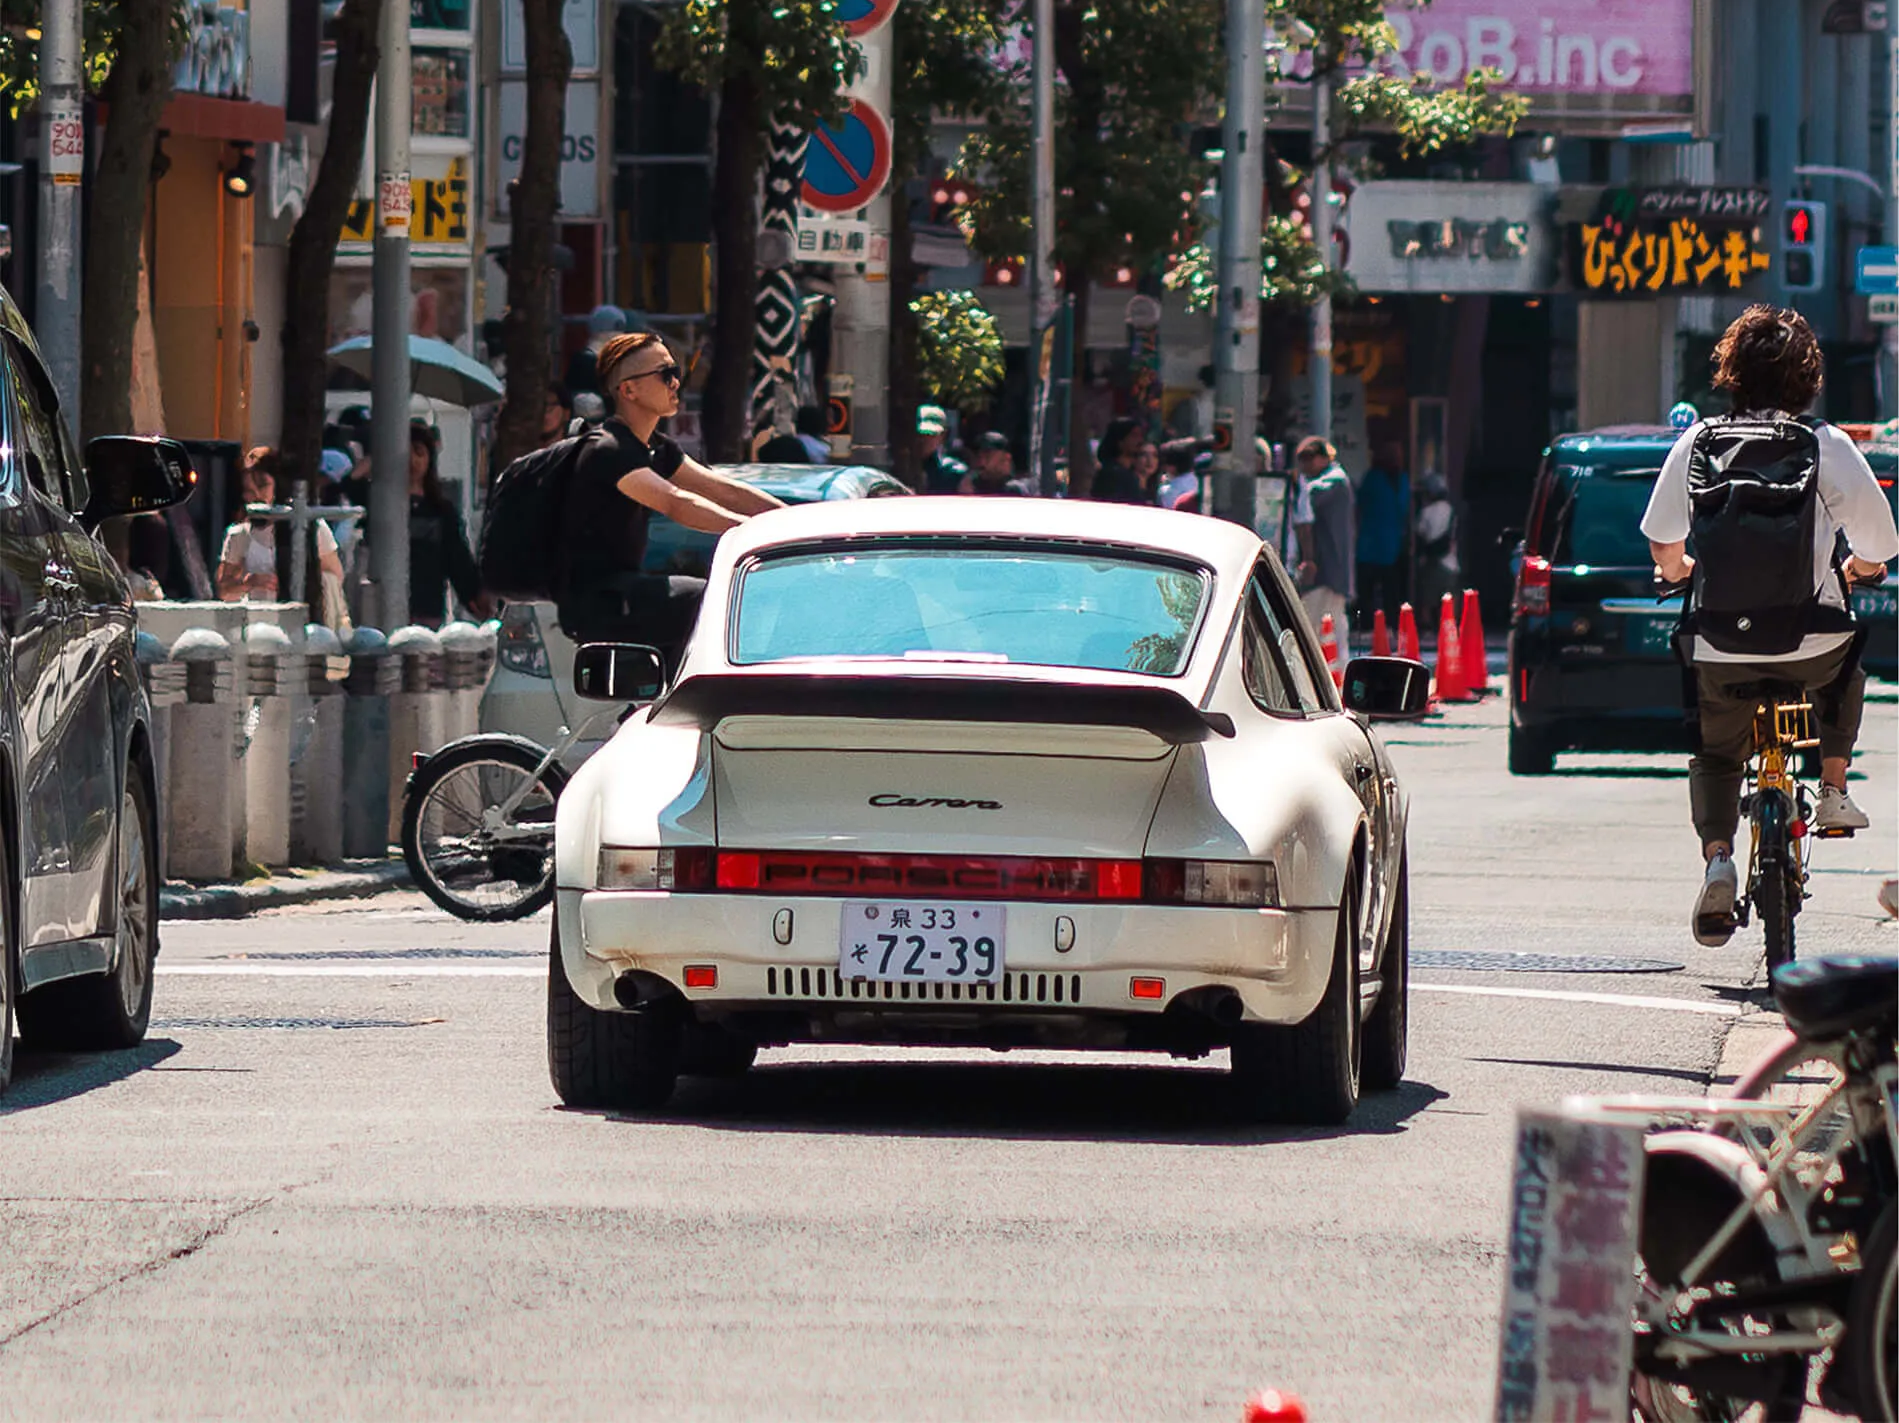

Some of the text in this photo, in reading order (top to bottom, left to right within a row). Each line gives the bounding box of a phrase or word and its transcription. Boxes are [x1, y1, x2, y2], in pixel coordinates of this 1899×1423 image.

[1582, 214, 1770, 293] びっくりドンキー
[868, 794, 1003, 810] Carrera
[764, 864, 1092, 893] PORSCHE
[891, 908, 956, 930] 泉 33
[851, 933, 996, 977] そ 72-39
